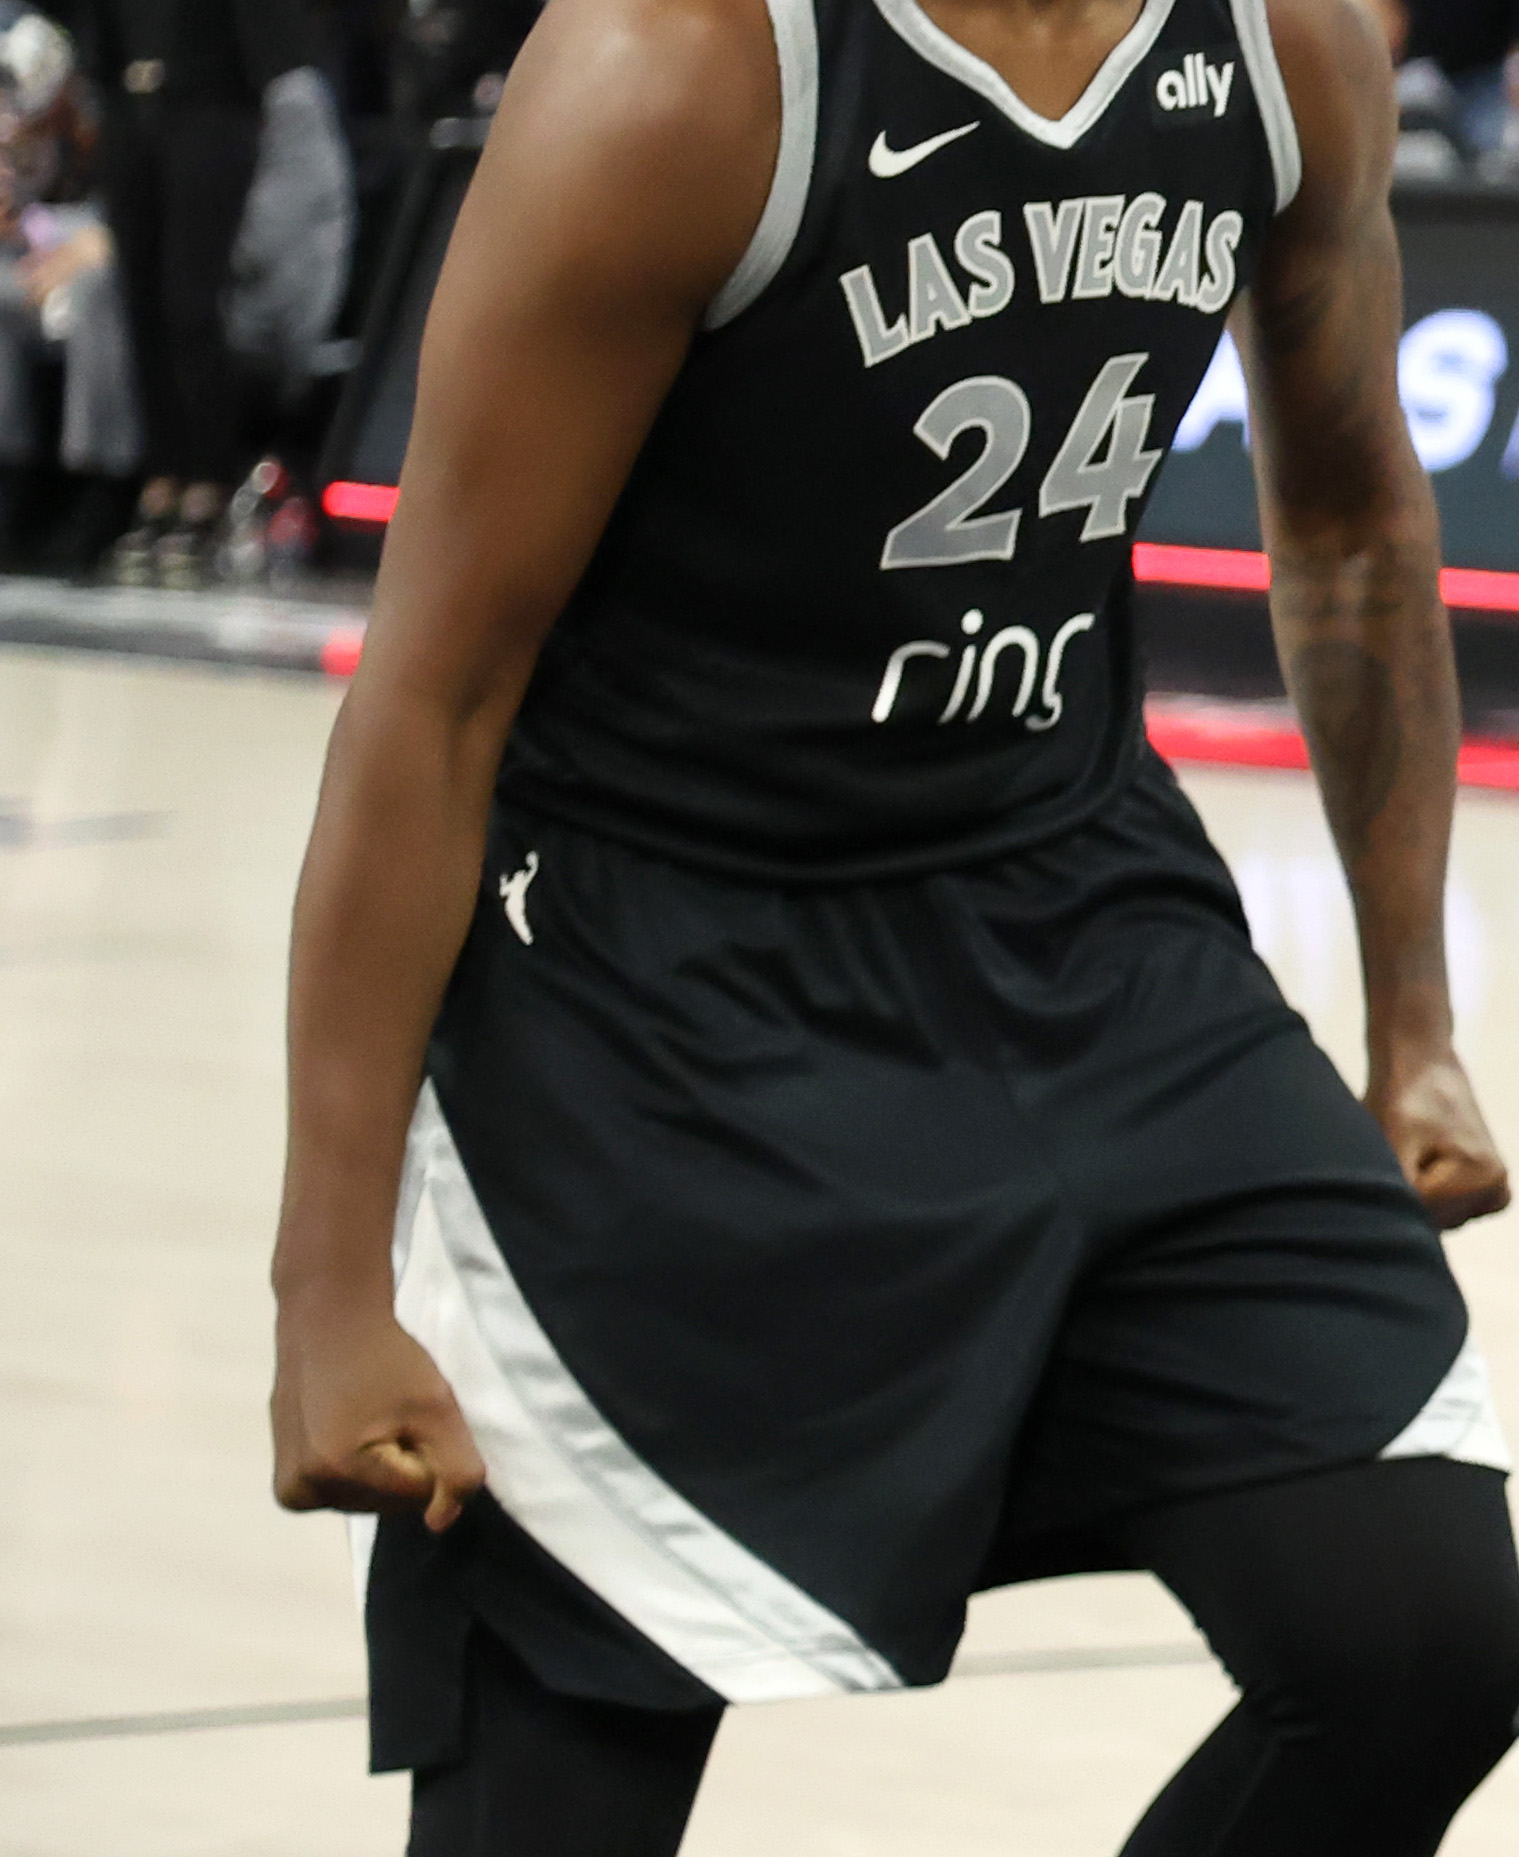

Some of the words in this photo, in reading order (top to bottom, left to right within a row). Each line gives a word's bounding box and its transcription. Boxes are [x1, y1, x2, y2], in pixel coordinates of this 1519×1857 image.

[1156, 52, 1235, 118] ally
[839, 210, 1015, 368] LAS
[1023, 191, 1244, 314] VEGAS
[880, 351, 1164, 571] 24
